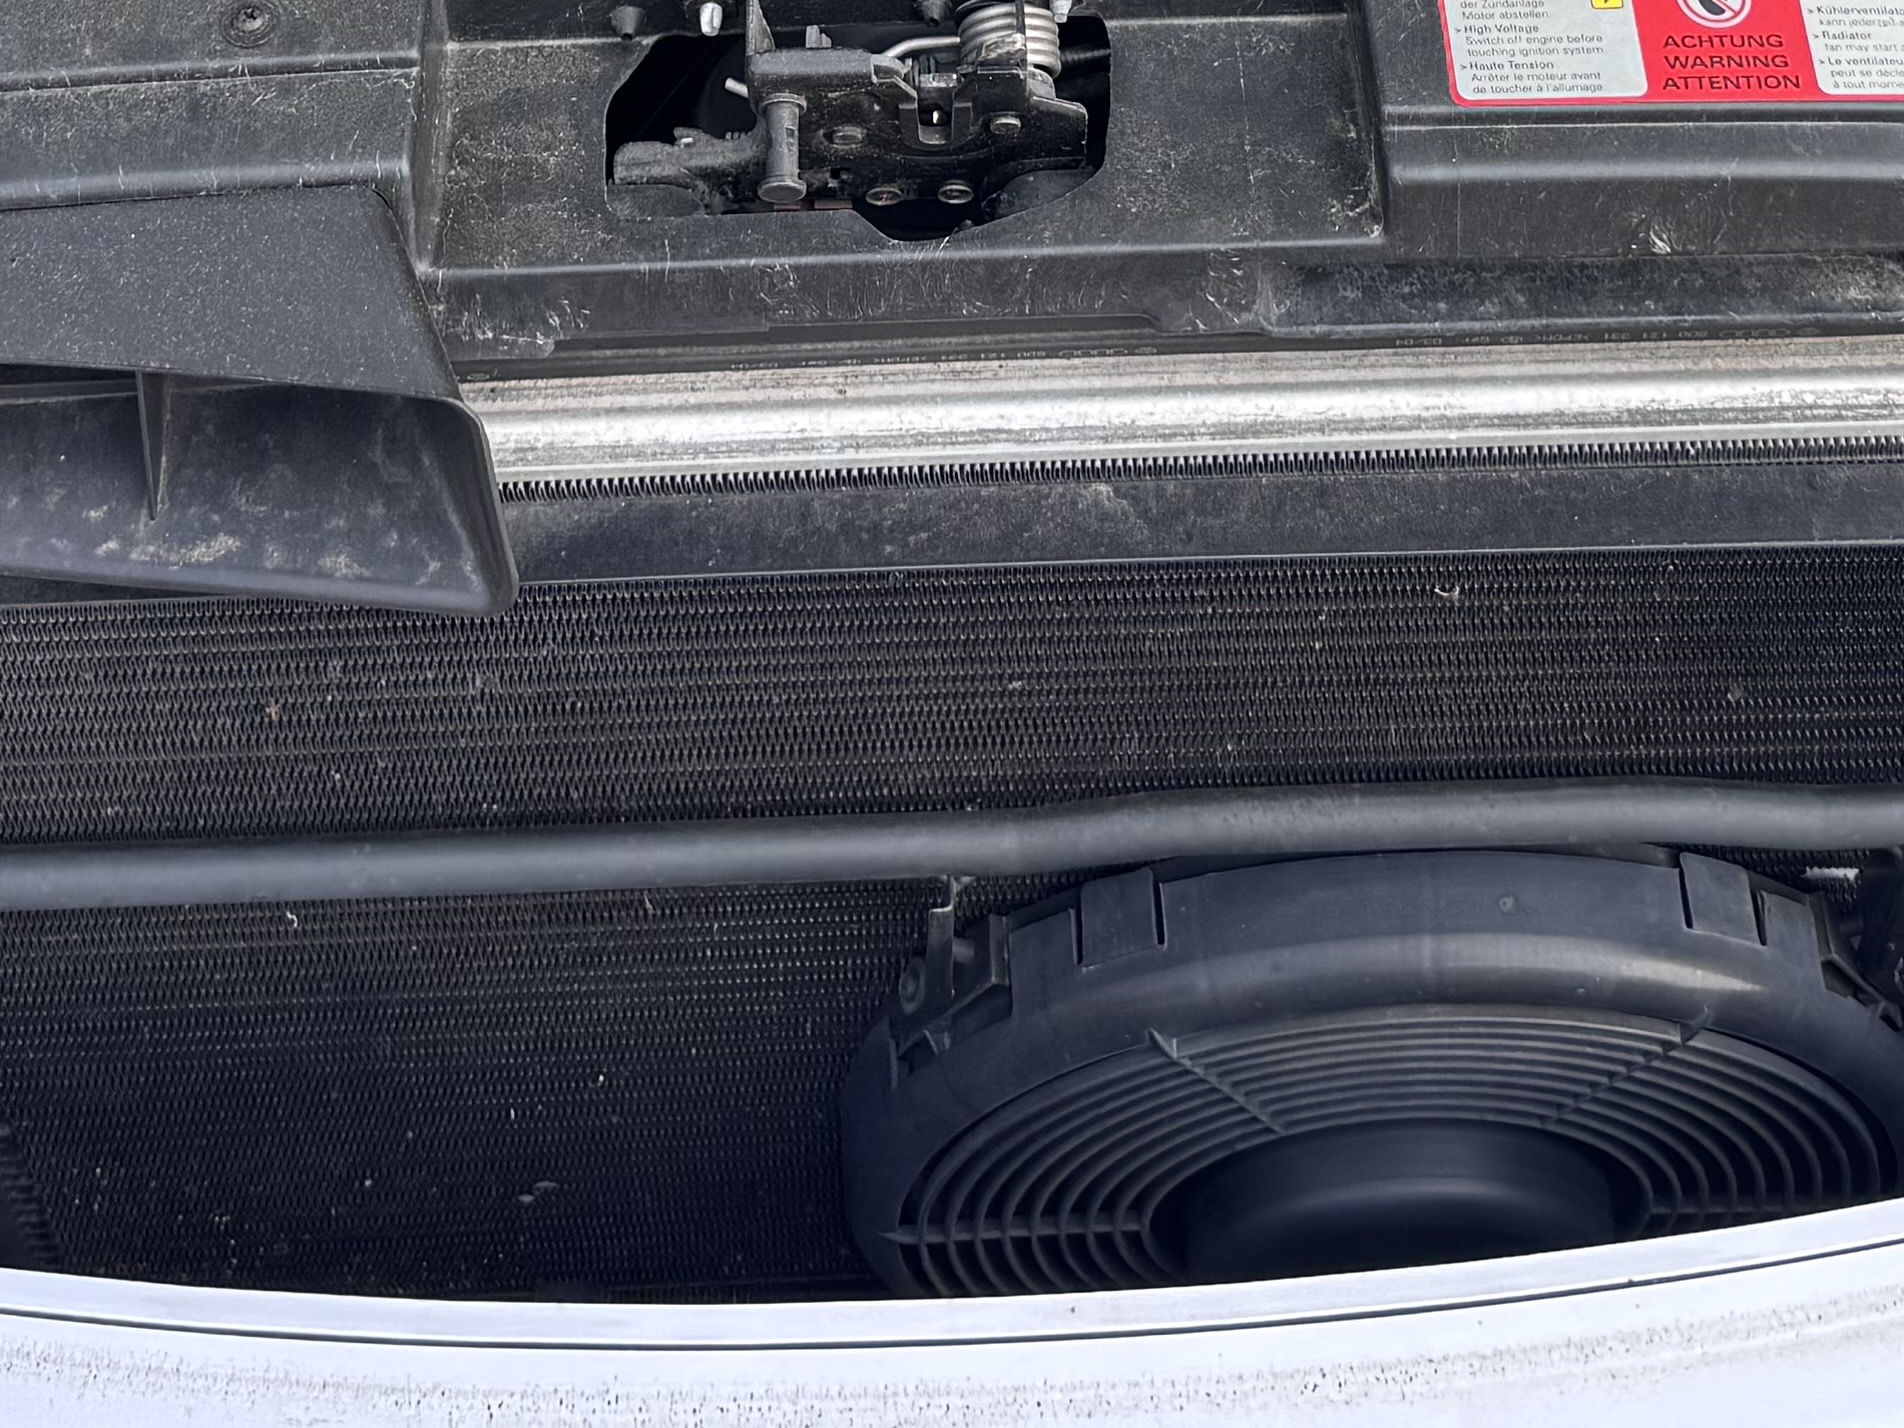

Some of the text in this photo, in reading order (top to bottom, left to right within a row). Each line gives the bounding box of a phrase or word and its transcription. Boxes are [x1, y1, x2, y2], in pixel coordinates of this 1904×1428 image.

[1459, 0, 1478, 9] der
[1461, 10, 1496, 20] Motor
[1818, 16, 1847, 27] kann
[1463, 23, 1540, 35] High Voltage
[1464, 33, 1604, 46] Switch off engine before
[1663, 33, 1784, 49] ACHTUNG
[1821, 30, 1873, 41] Radiator
[1466, 46, 1517, 58] touching
[1517, 46, 1560, 57] ignition
[1823, 42, 1843, 53] fan
[1843, 43, 1870, 54] may
[1871, 42, 1899, 53] start
[1468, 59, 1554, 71] Haute Tension
[1663, 54, 1790, 70] WARNING
[1826, 56, 1843, 66] Le
[1469, 70, 1602, 83] Arrêter le moteur avant
[1829, 68, 1857, 79] peut
[1858, 69, 1874, 78] se
[1662, 74, 1801, 90] ATTENTION
[1841, 80, 1867, 89] tout
[1471, 83, 1487, 94] de
[1489, 83, 1534, 94] toucher
